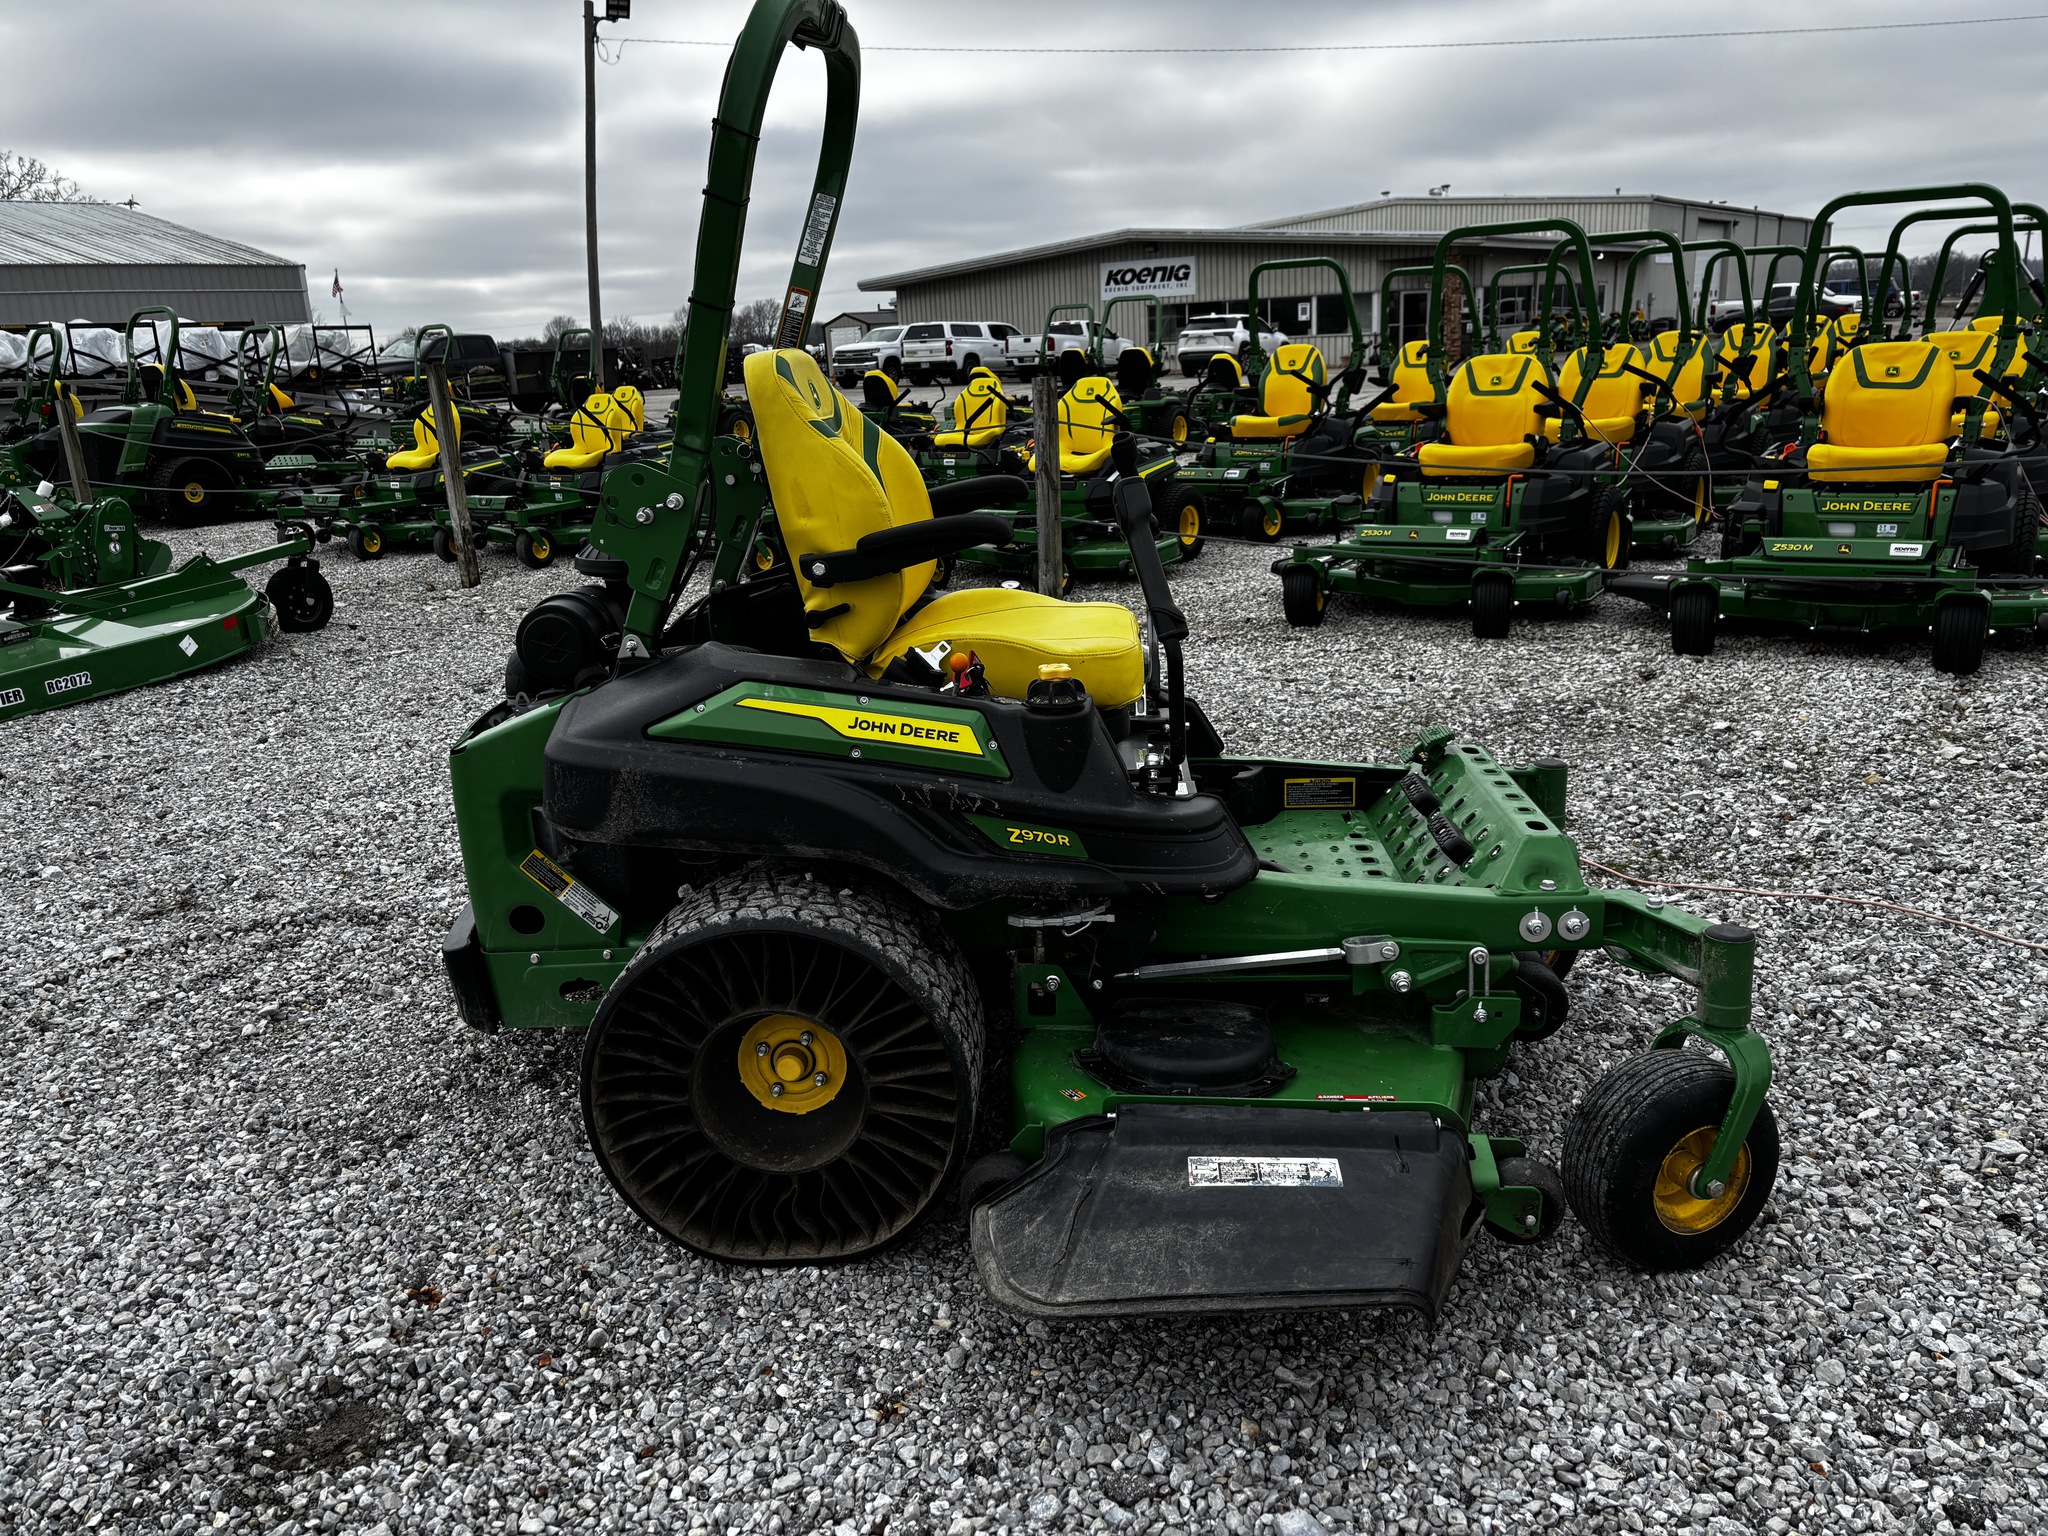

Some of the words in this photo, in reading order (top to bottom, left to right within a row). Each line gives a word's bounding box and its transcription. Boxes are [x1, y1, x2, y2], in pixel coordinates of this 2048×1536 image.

[1104, 285, 1129, 293] KOENIG
[1131, 283, 1173, 292] EQUIPMENT,
[1427, 492, 1455, 501] JOHN
[1457, 492, 1493, 502] DEERE
[1822, 501, 1860, 511] JOHN
[1863, 501, 1911, 511] DEERE
[46, 672, 91, 694] RC2072
[847, 716, 897, 735] JOHN
[899, 722, 960, 743] DEERE
[1006, 827, 1071, 847] Z970R
[544, 859, 565, 877] CAUTION
